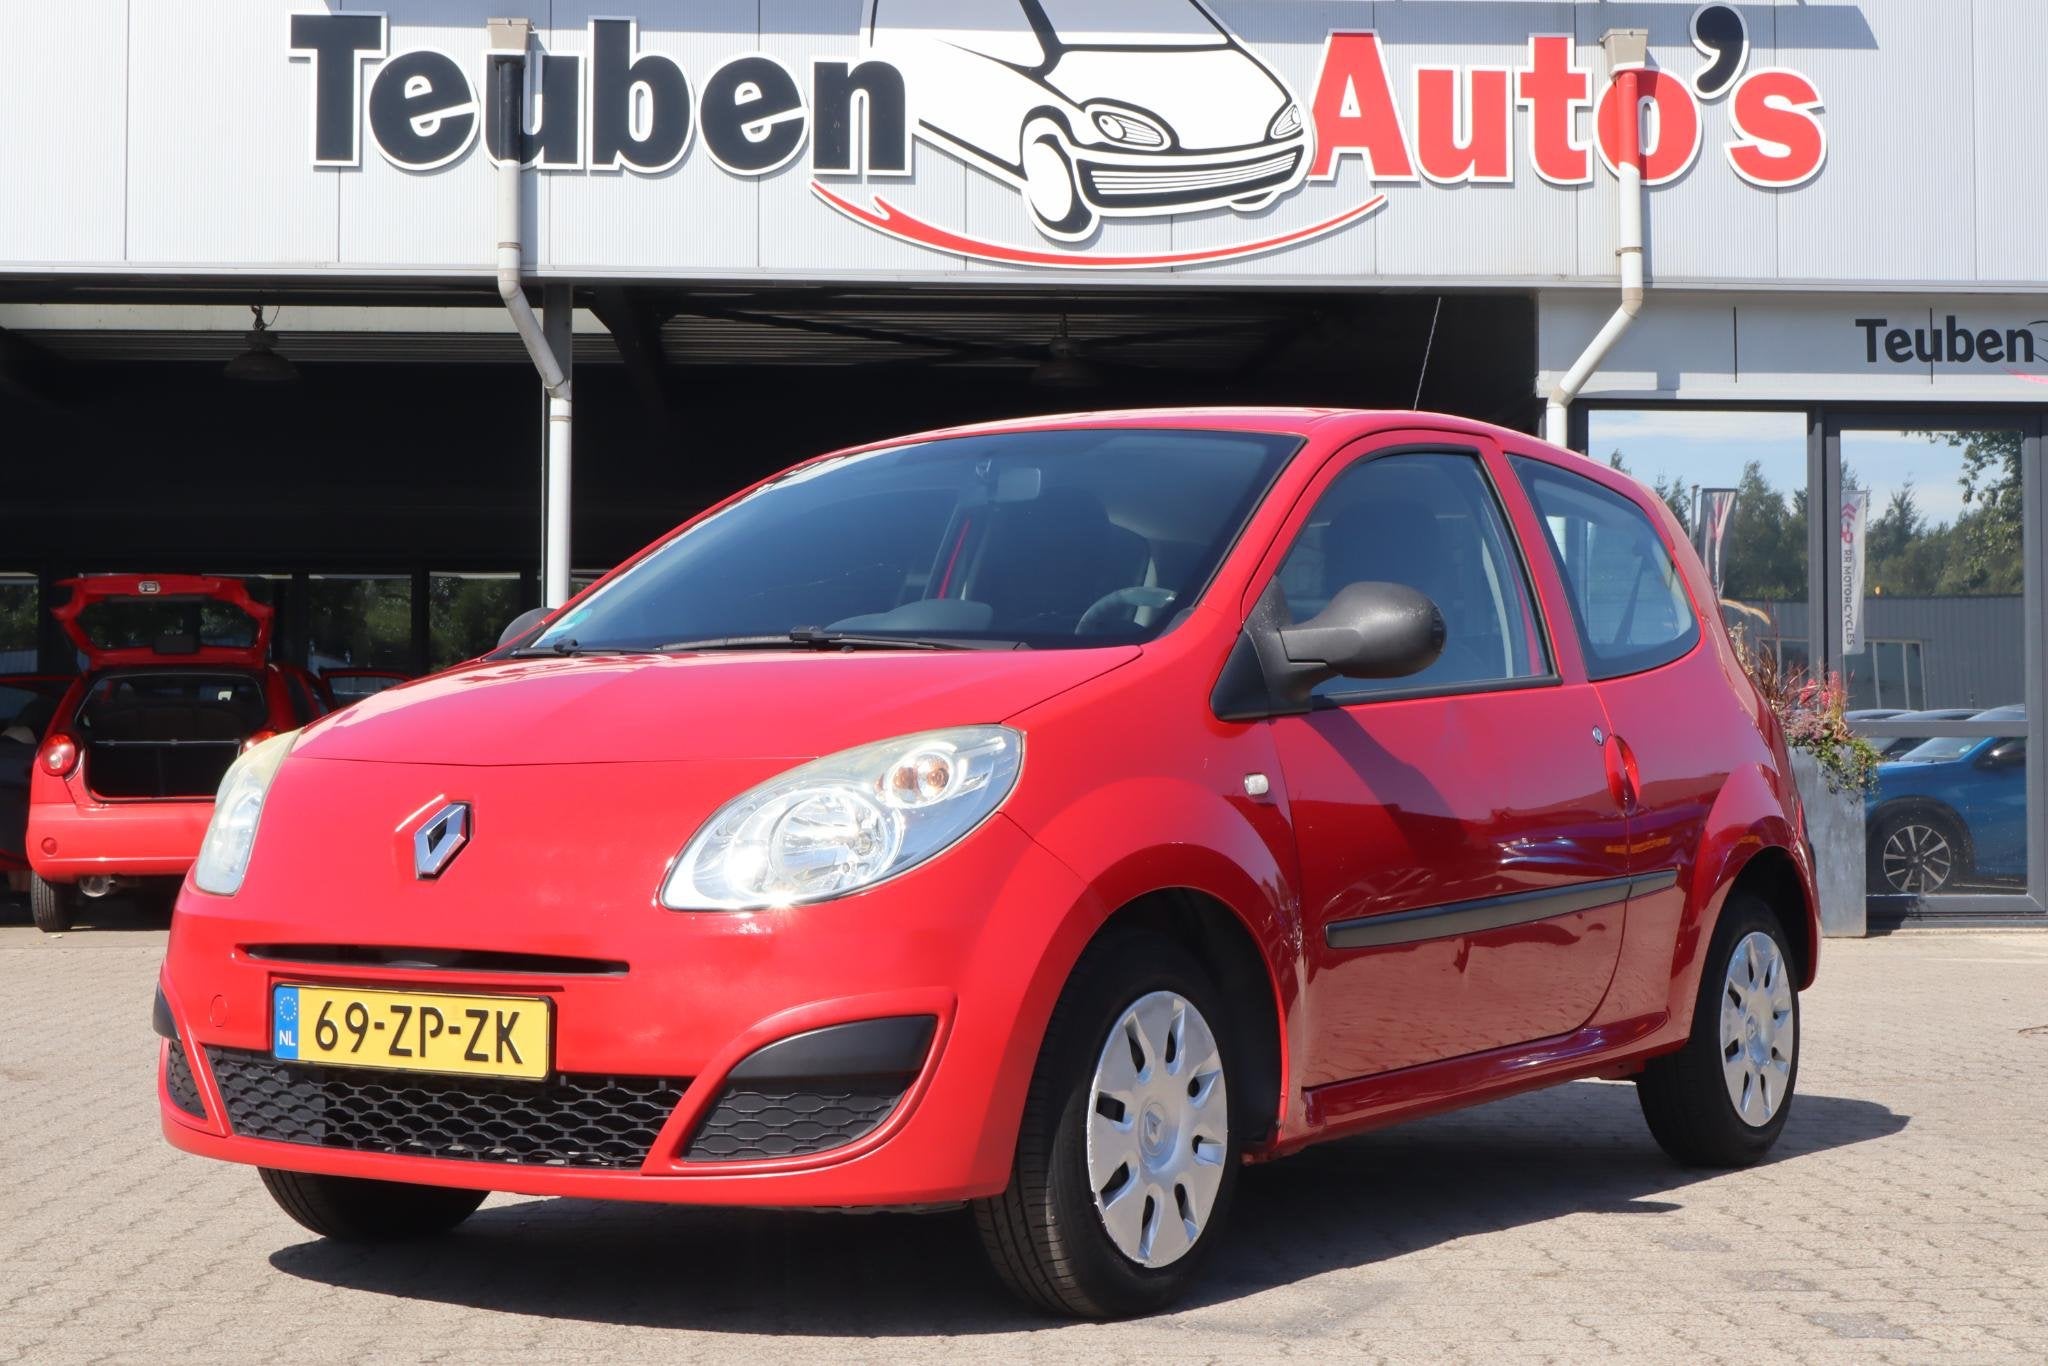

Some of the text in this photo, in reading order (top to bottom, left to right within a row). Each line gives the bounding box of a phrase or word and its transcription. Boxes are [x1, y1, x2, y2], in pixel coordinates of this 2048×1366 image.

[290, 13, 910, 174] Teuben
[1855, 314, 2034, 363] Teuben
[1843, 566, 1855, 646] MOTORCYCLES
[279, 1030, 296, 1047] NL
[315, 1000, 523, 1064] 69-ZP-ZK
